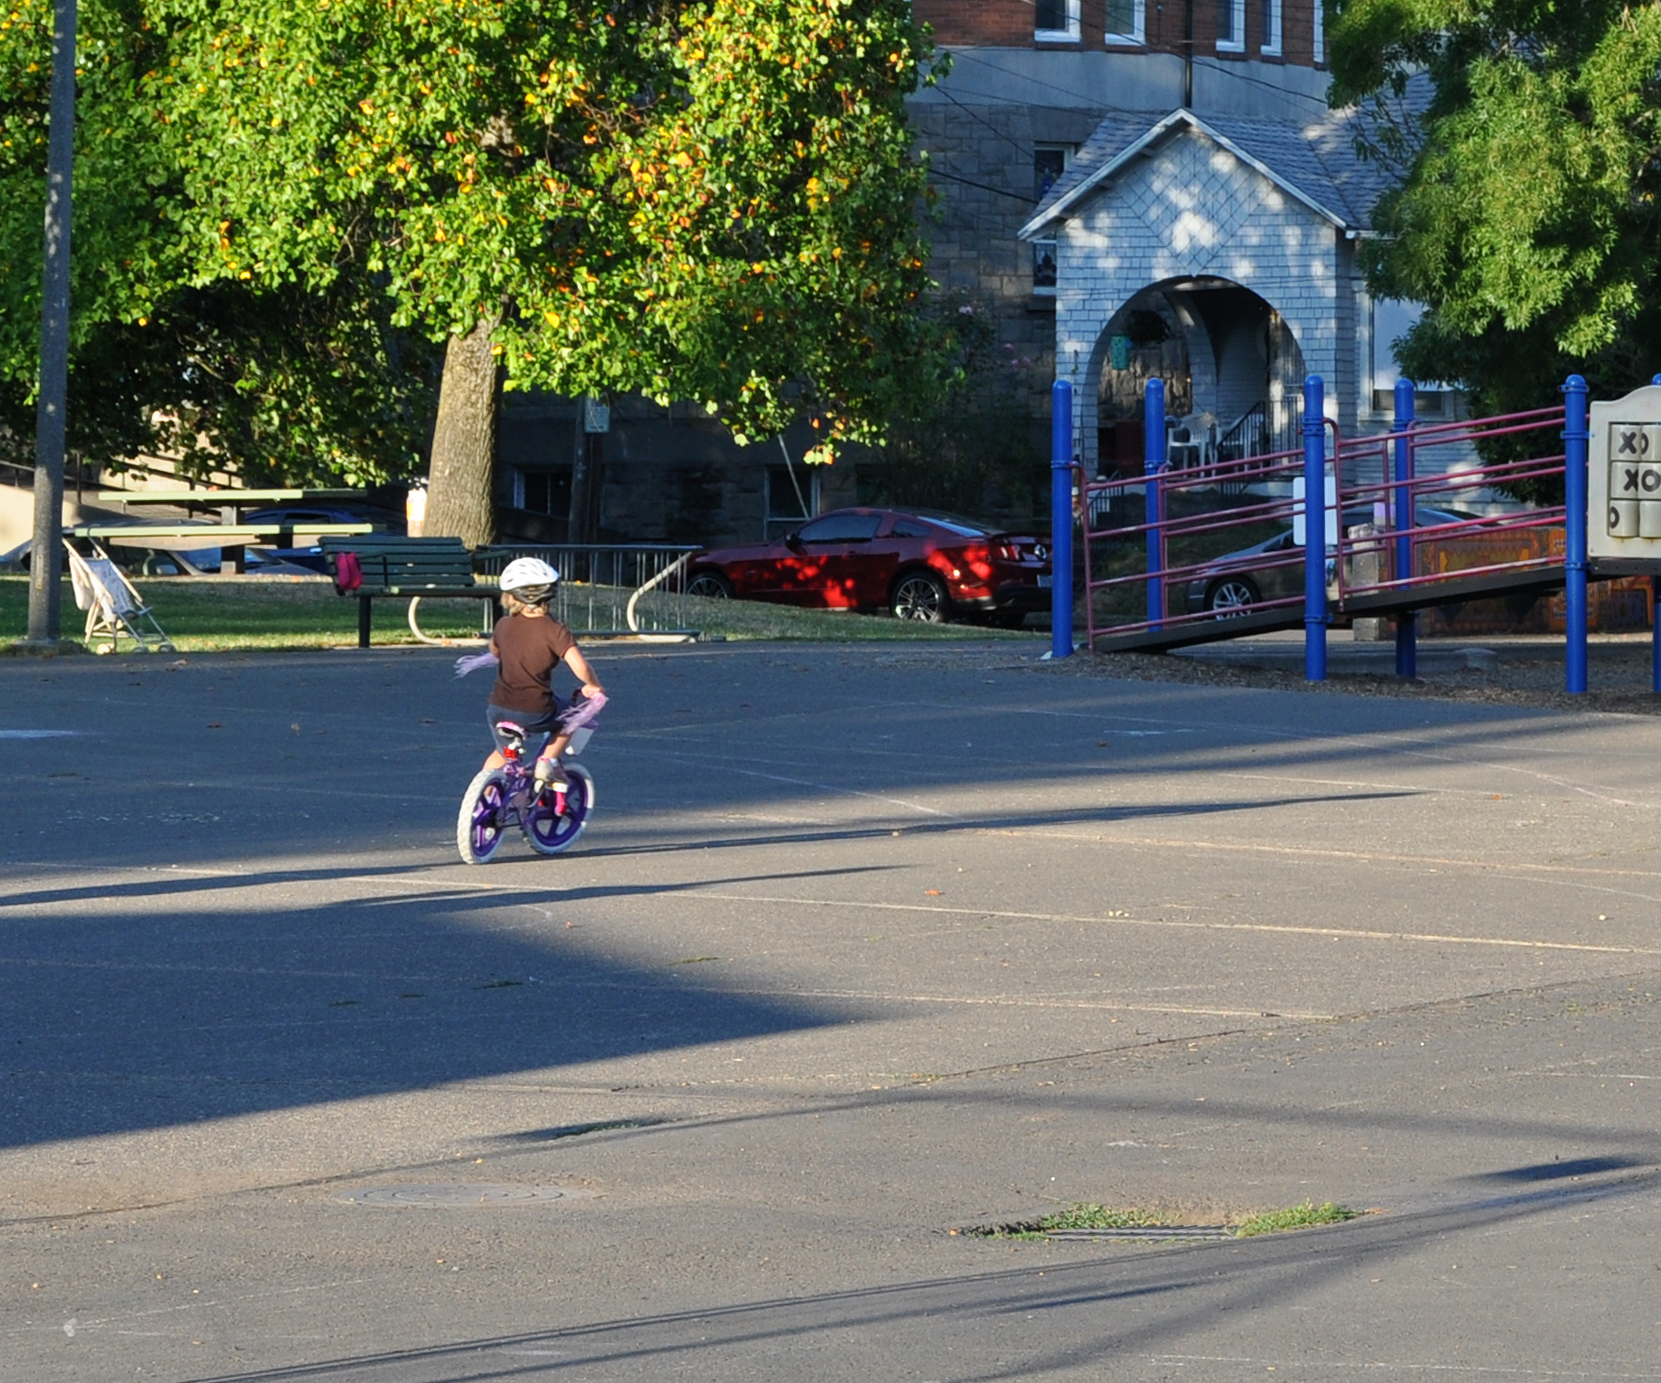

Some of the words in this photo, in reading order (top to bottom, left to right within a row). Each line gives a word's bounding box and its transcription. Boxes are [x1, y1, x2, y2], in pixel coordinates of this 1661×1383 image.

[1618, 431, 1637, 454] X
[1623, 468, 1638, 492] X
[1641, 469, 1661, 492] O
